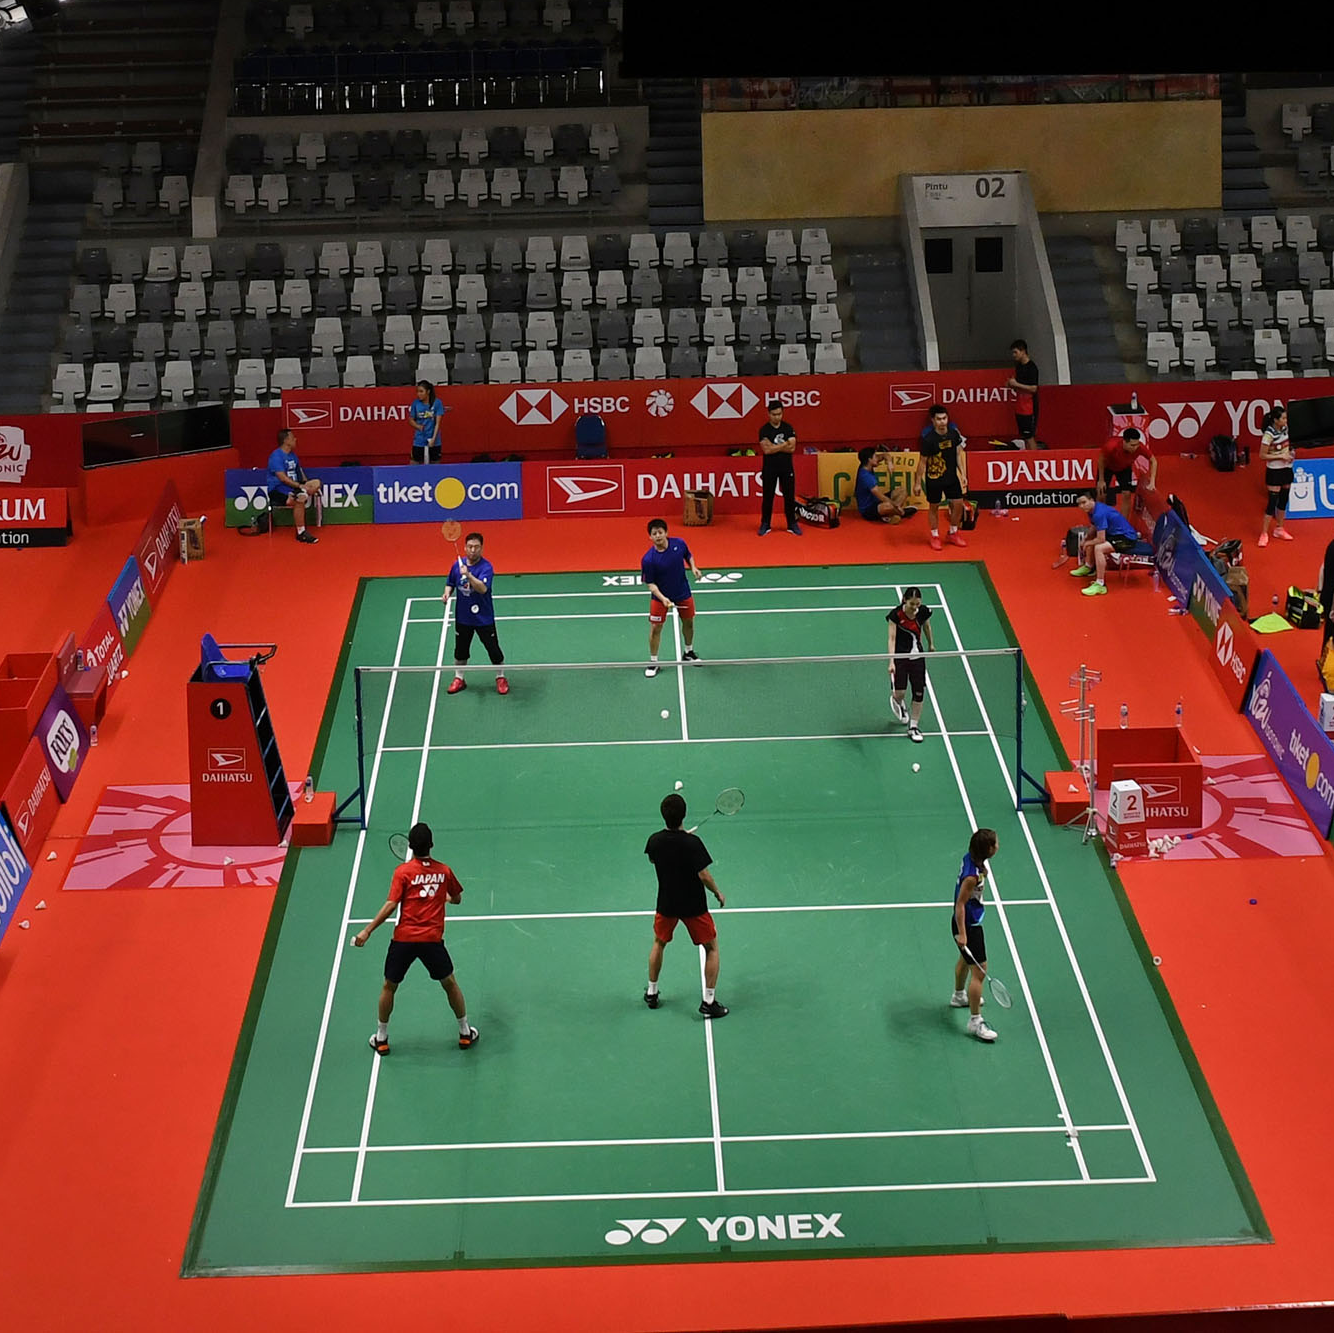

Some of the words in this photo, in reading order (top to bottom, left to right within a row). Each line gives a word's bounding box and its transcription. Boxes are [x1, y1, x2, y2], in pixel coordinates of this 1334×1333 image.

[925, 182, 948, 190] Pintu
[975, 177, 1005, 198] 02
[765, 390, 821, 408] HSBC
[942, 387, 1017, 404] DAIHATS
[339, 406, 411, 421] DAIHAT
[574, 397, 630, 414] HSBC
[987, 458, 1094, 485] DJARUM
[95, 631, 115, 663] TOTAL
[1230, 651, 1247, 684] HSBC
[216, 702, 226, 716] 1
[202, 772, 253, 783] DAIHATSU
[27, 764, 52, 816] DAIHATSU
[1127, 795, 1137, 811] 2
[1146, 806, 1189, 818] IHATSU
[411, 873, 445, 885] JAPAN
[696, 1213, 845, 1242] YONEX
